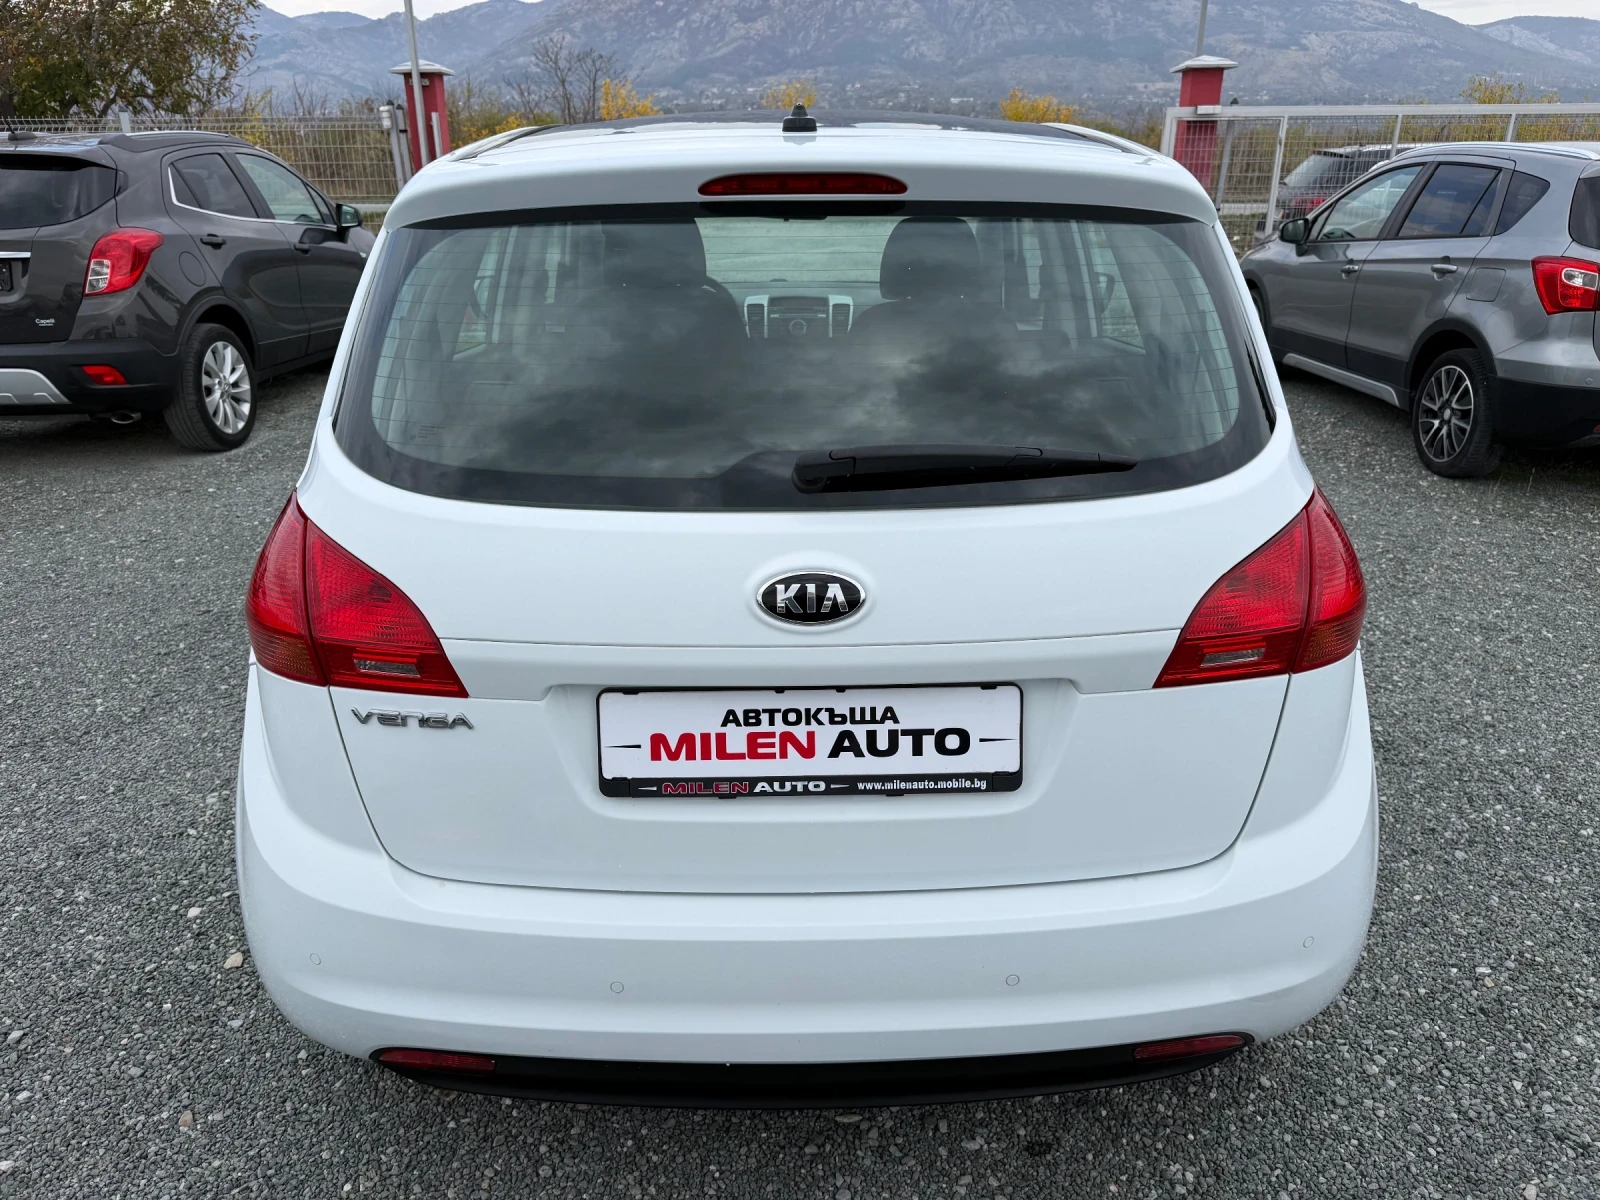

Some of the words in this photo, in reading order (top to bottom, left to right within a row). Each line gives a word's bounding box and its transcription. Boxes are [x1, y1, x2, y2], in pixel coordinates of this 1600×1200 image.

[775, 583, 849, 613] KIA
[649, 730, 816, 762] MILEN
[827, 727, 971, 759] AUTO
[661, 781, 749, 794] MILEN
[753, 780, 826, 793] AUTO
[857, 778, 987, 790] www.milenauto.mobile.bg
